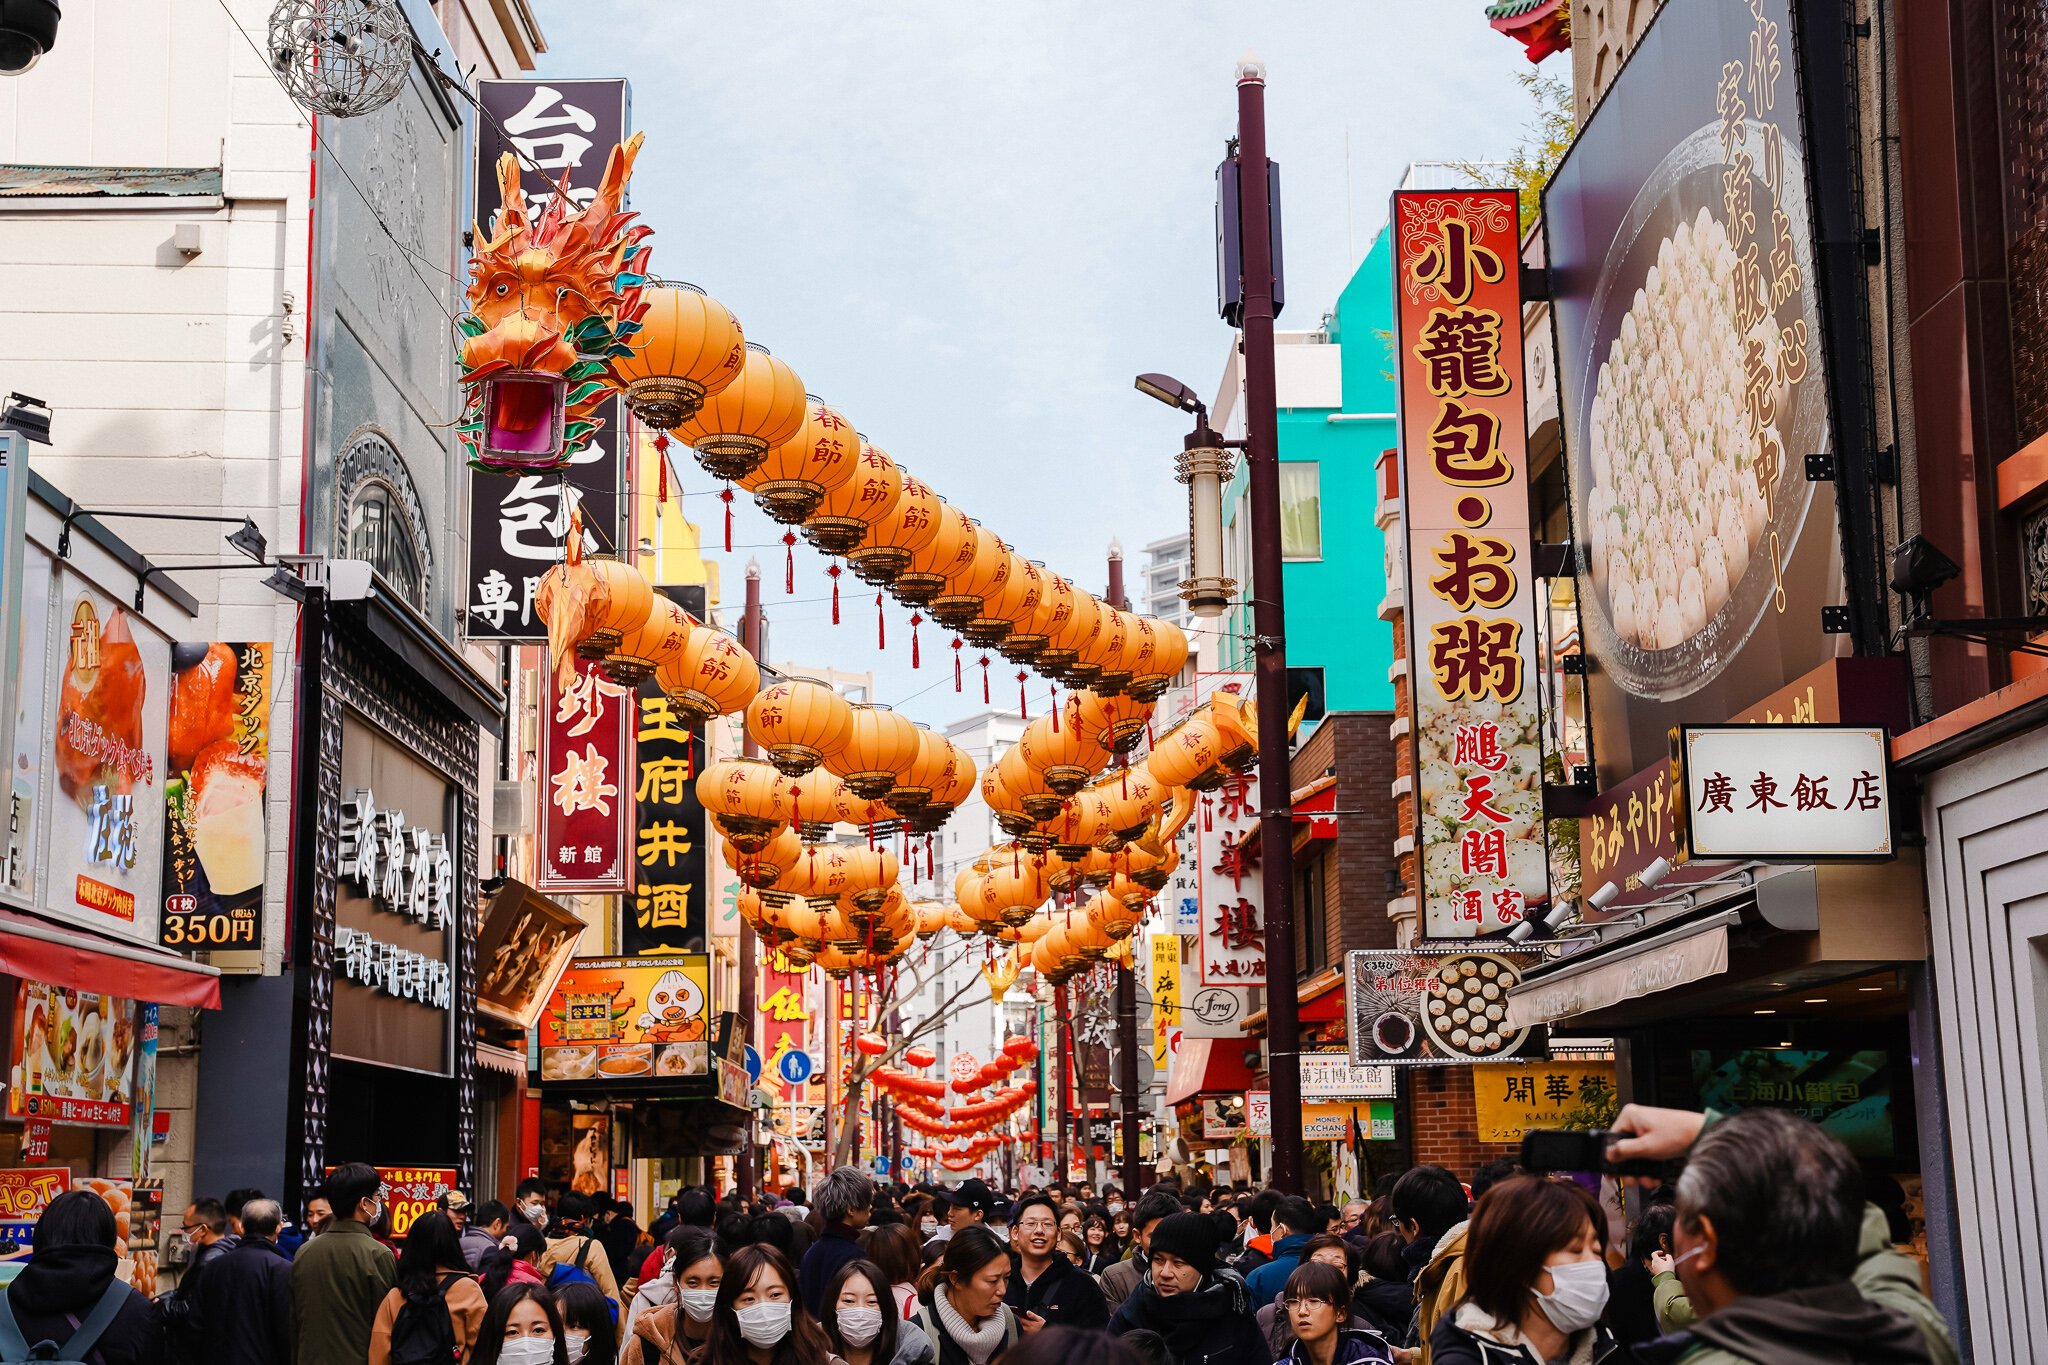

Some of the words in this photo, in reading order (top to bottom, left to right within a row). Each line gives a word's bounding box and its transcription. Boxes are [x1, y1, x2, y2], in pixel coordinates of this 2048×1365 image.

[1748, 0, 1808, 388] 作り点心
[812, 407, 848, 465] 春節
[861, 447, 893, 504] 春節
[1411, 217, 1523, 704] 小籠包・お粥
[902, 476, 931, 530] 春節
[1052, 575, 1072, 622] 春節
[70, 618, 101, 672] 元祖
[662, 606, 689, 651] 春節
[700, 636, 741, 682] 春節
[239, 647, 265, 756] 北京ダック
[760, 686, 789, 729] 春節
[1182, 731, 1212, 767] 春節
[726, 768, 747, 807] 春節
[1132, 783, 1155, 820] 春節
[1453, 720, 1513, 881] 鵬天閣
[1697, 770, 1882, 814] 廣東飯店
[183, 785, 198, 881] 本場北京ダック
[635, 697, 693, 956] 王府井酒
[1094, 800, 1112, 838] 春節
[558, 845, 604, 865] 新館
[828, 853, 847, 887] 春節
[170, 897, 195, 911] 1枚
[230, 908, 257, 919] (税込)
[1451, 887, 1524, 926] 酒家
[163, 914, 255, 945] 350円
[1155, 941, 1166, 963] 料理
[1167, 941, 1177, 963] 広東
[1209, 959, 1266, 977] 大通り店
[1363, 961, 1395, 971] ぐるなび
[1397, 958, 1440, 971] 2年連続
[1375, 976, 1440, 992] 第1位獲得
[751, 1094, 758, 1106] 2
[1250, 1100, 1269, 1119] 京
[28, 1139, 48, 1157] 注文口
[384, 1170, 442, 1183] 小籠包専門店
